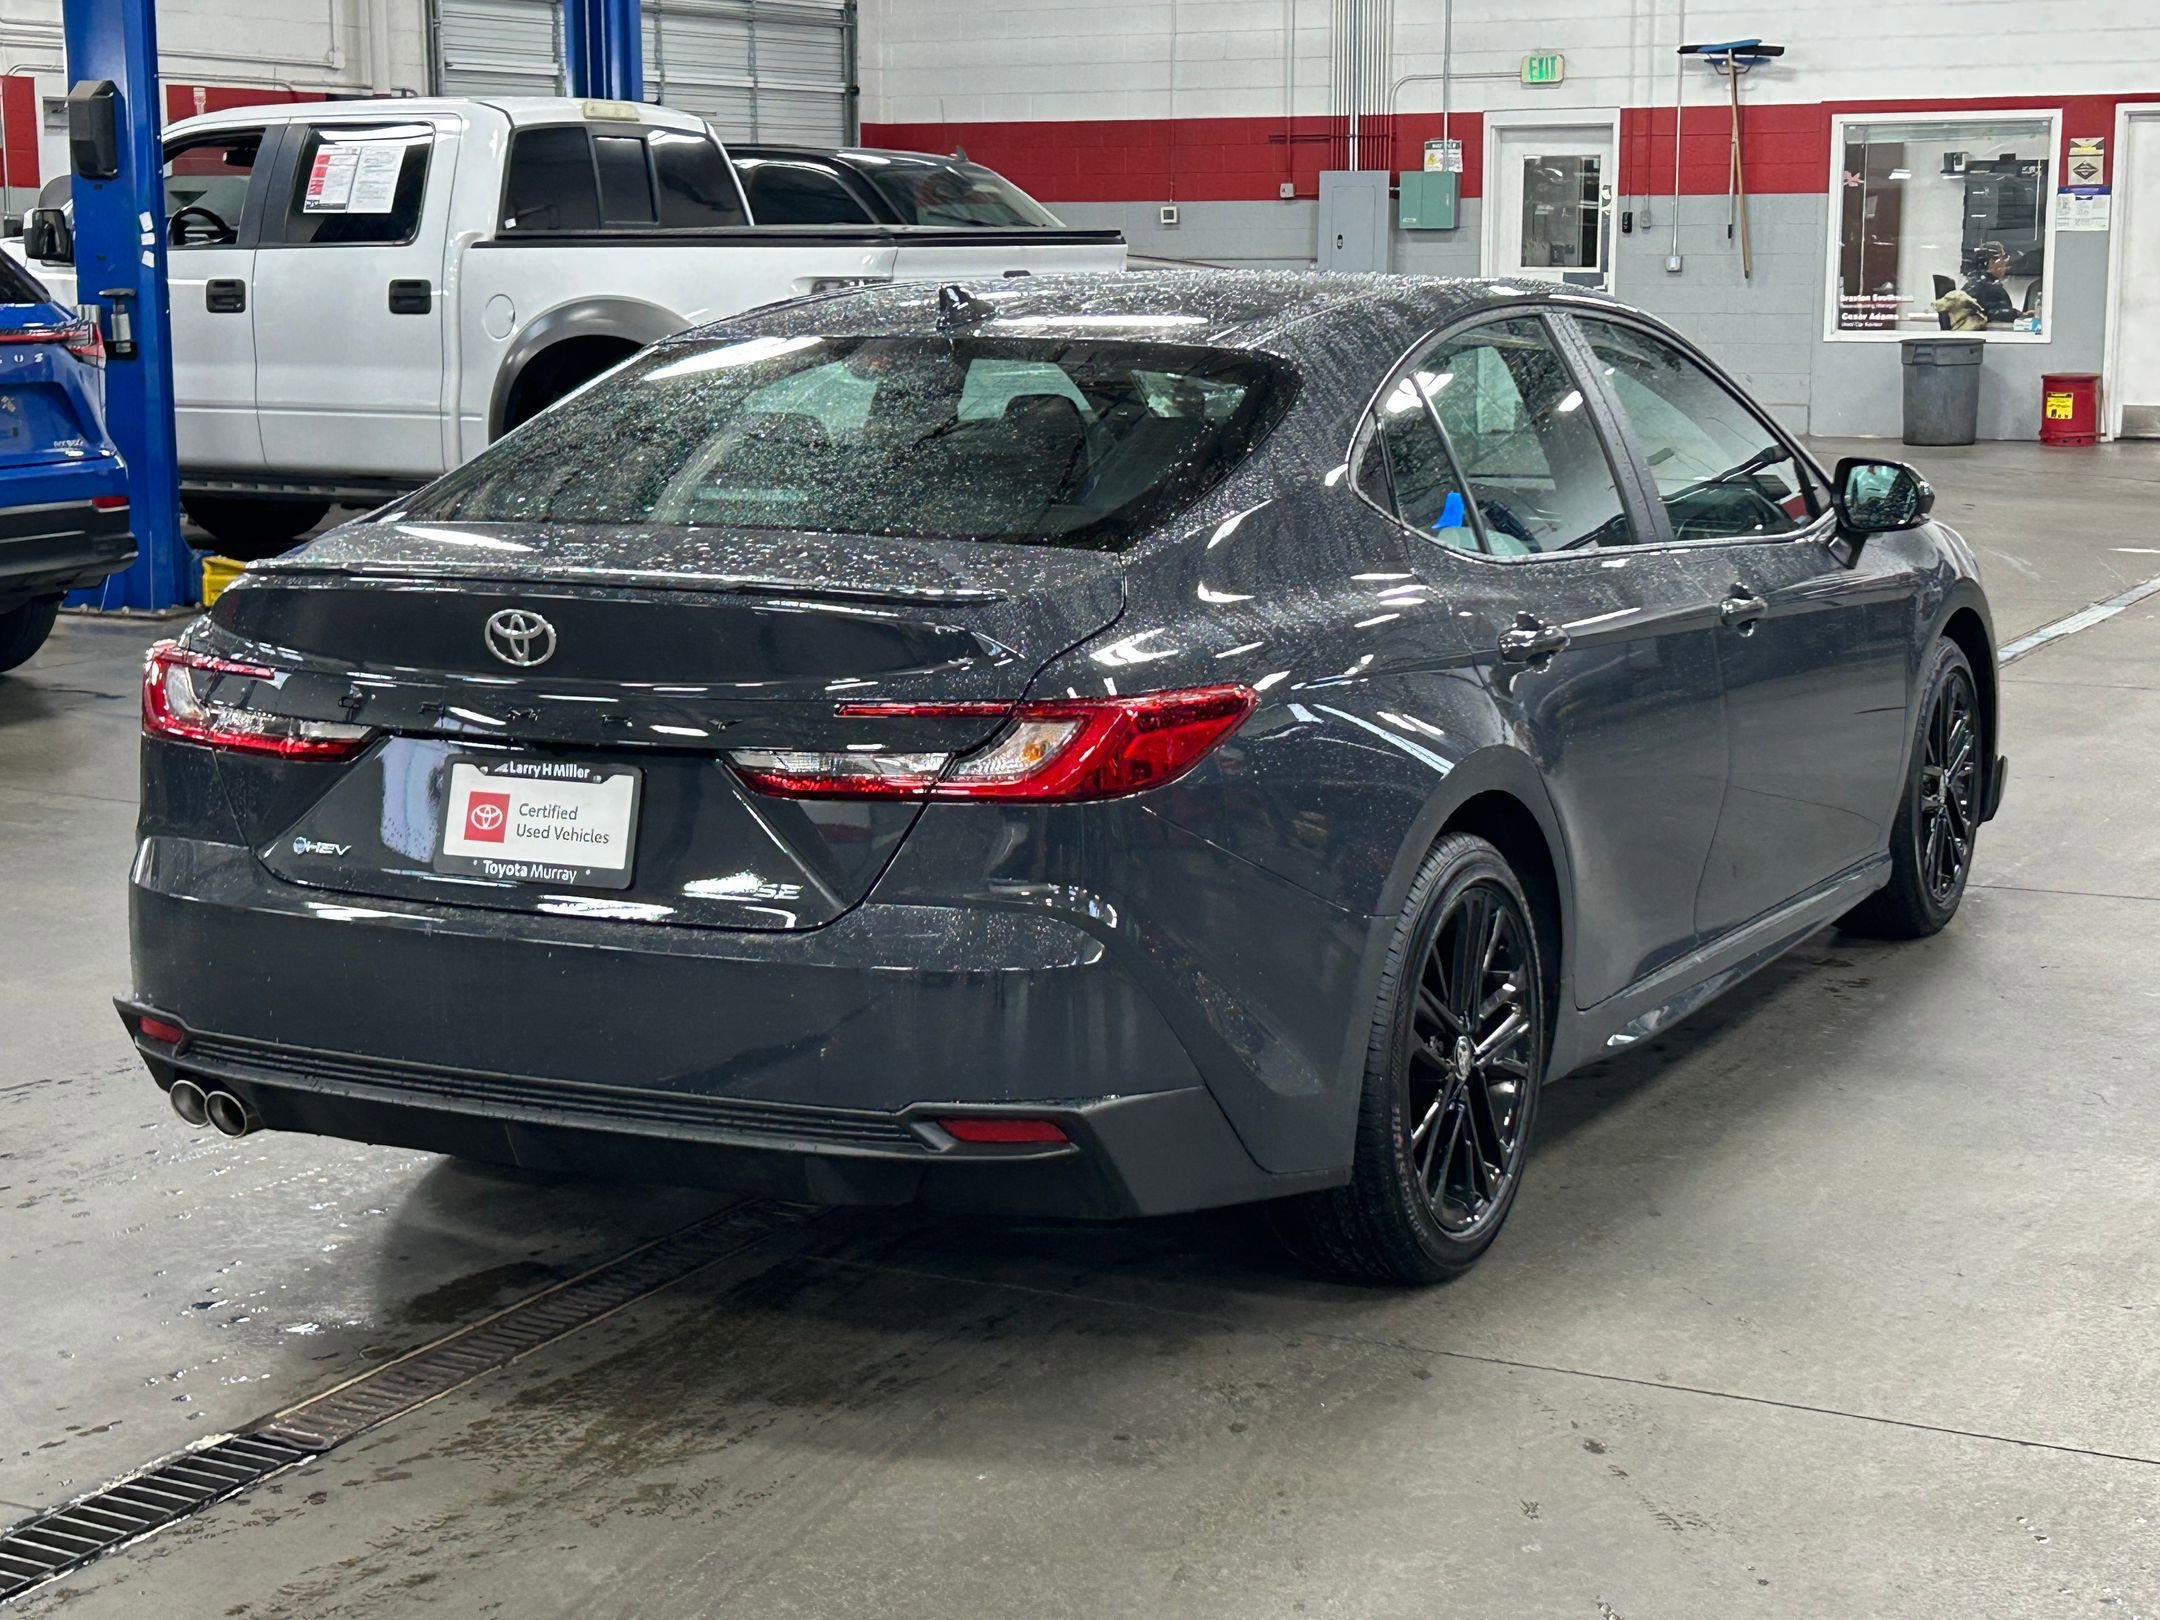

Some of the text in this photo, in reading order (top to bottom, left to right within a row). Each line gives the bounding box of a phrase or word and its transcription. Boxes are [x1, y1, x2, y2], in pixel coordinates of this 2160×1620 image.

[1528, 55, 1557, 81] EXIT
[509, 761, 590, 778] Larry H Miller
[519, 803, 578, 820] Certified
[516, 824, 610, 844] Used Vehicles
[305, 840, 352, 855] HEV
[483, 860, 577, 884] Toyota Murray
[753, 883, 803, 900] SE
